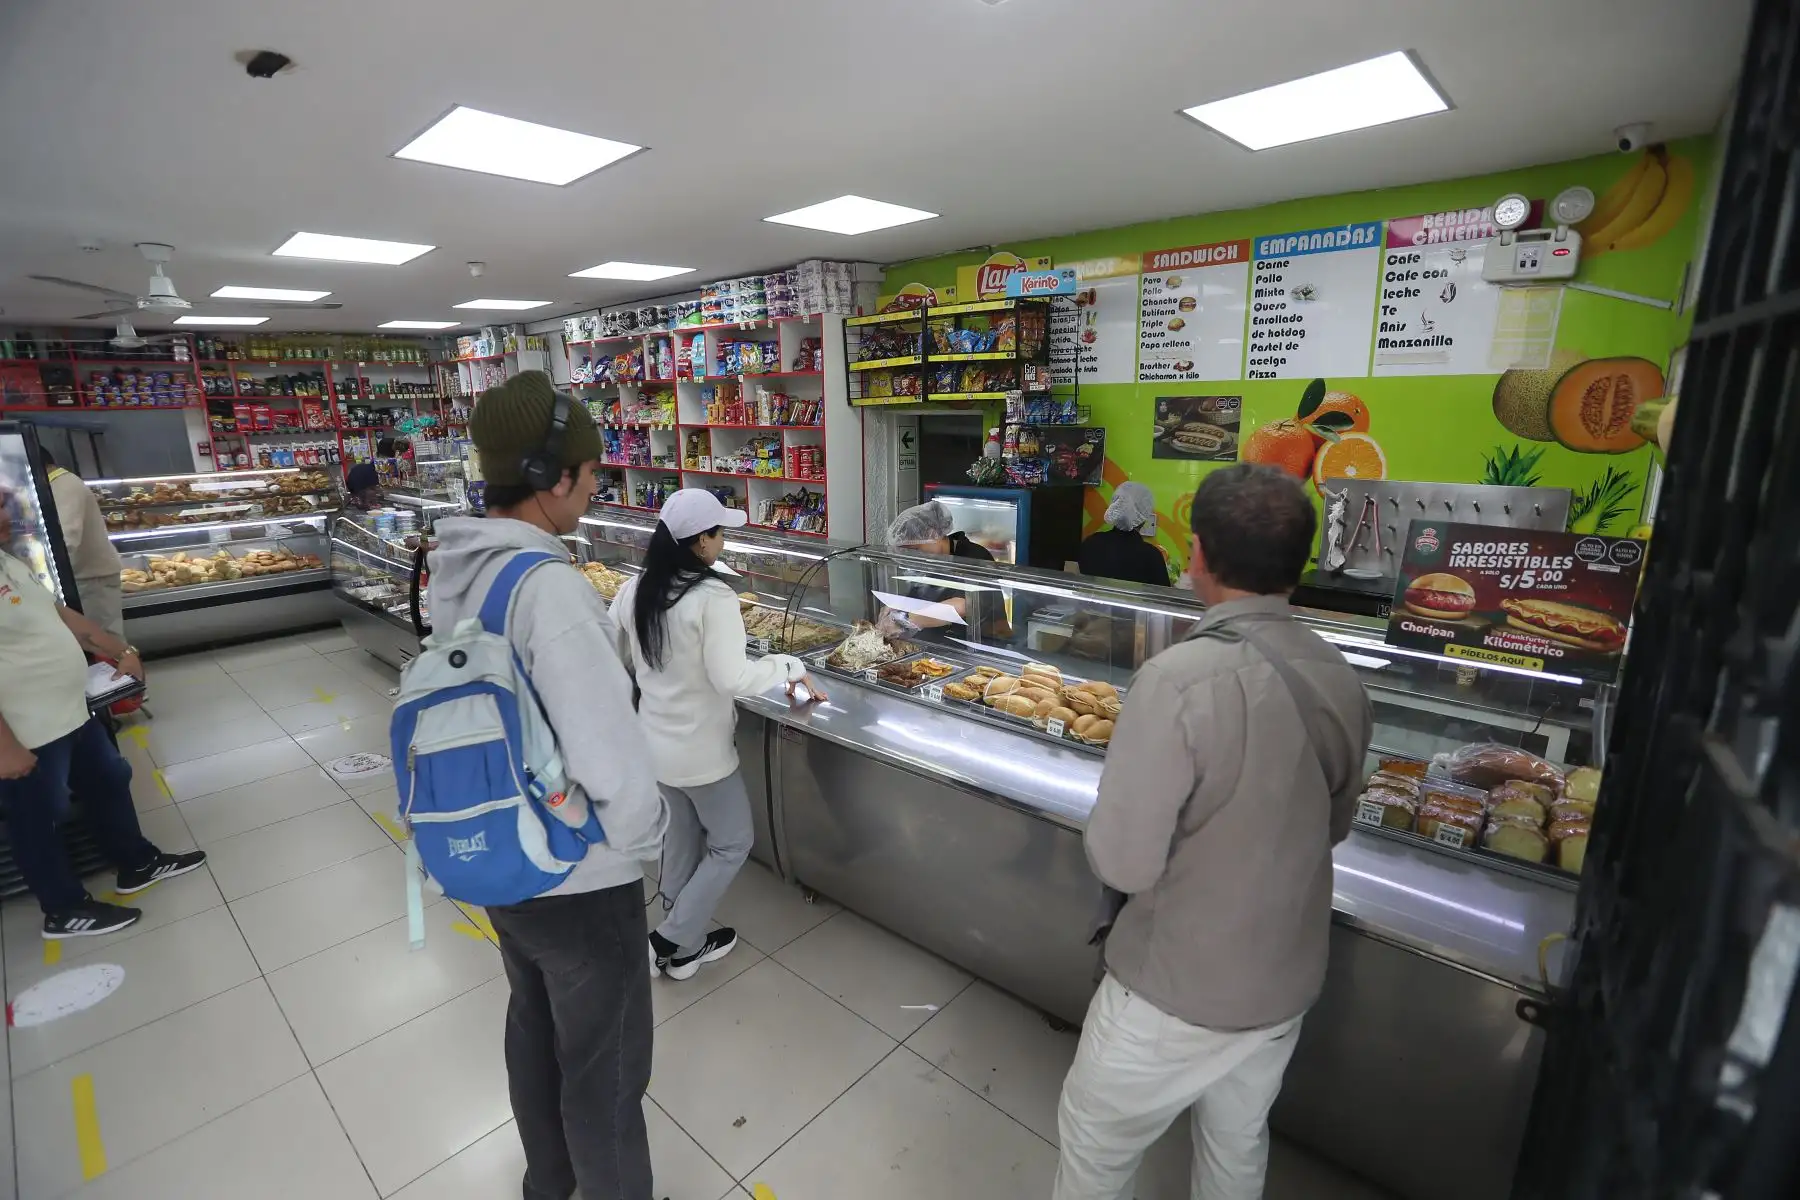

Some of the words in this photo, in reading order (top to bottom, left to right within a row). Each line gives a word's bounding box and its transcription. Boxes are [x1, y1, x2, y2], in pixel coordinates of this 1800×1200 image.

[1423, 208, 1493, 229] BEBIDA
[1412, 222, 1499, 246] CALIENT
[1260, 226, 1376, 255] EMPANADAS
[1153, 245, 1238, 269] SANDWICH
[1387, 254, 1421, 266] Cafe
[1256, 260, 1290, 270] Carne
[1143, 277, 1161, 285] Pavo
[1255, 274, 1283, 284] Pollo
[1385, 272, 1418, 283] Cafe
[1423, 269, 1448, 280] con
[1022, 275, 1059, 294] Karinto
[1143, 288, 1162, 296] Pollo
[1254, 288, 1285, 298] Mixta
[1384, 287, 1420, 299] leche
[1142, 297, 1178, 307] Chancho
[1253, 302, 1287, 312] Queso
[1382, 305, 1397, 316] Te
[1141, 320, 1164, 329] Triple
[1252, 314, 1303, 325] Enrollado
[1252, 329, 1265, 339] de
[1268, 327, 1306, 339] hotdog
[1380, 321, 1406, 333] Anis
[1141, 331, 1165, 339] Causa
[1141, 342, 1160, 350] Papa
[1251, 342, 1283, 352] Pastel
[1285, 341, 1299, 351] de
[1378, 335, 1453, 349] Manzanilla
[1250, 356, 1287, 367] acelga
[1050, 376, 1072, 384] hicha
[1186, 372, 1199, 380] kilo
[1249, 370, 1277, 379] Pizza
[1452, 542, 1529, 555] SABORES
[1449, 555, 1573, 569] IRRESISTIBLES
[1401, 621, 1455, 639] Choripan
[1503, 631, 1551, 645] Frankfurter
[1484, 635, 1564, 657] Kilométrico
[1460, 648, 1499, 662] PÍDELOS
[1500, 655, 1526, 666] AQUÍ
[447, 830, 491, 858] EVERLAST
